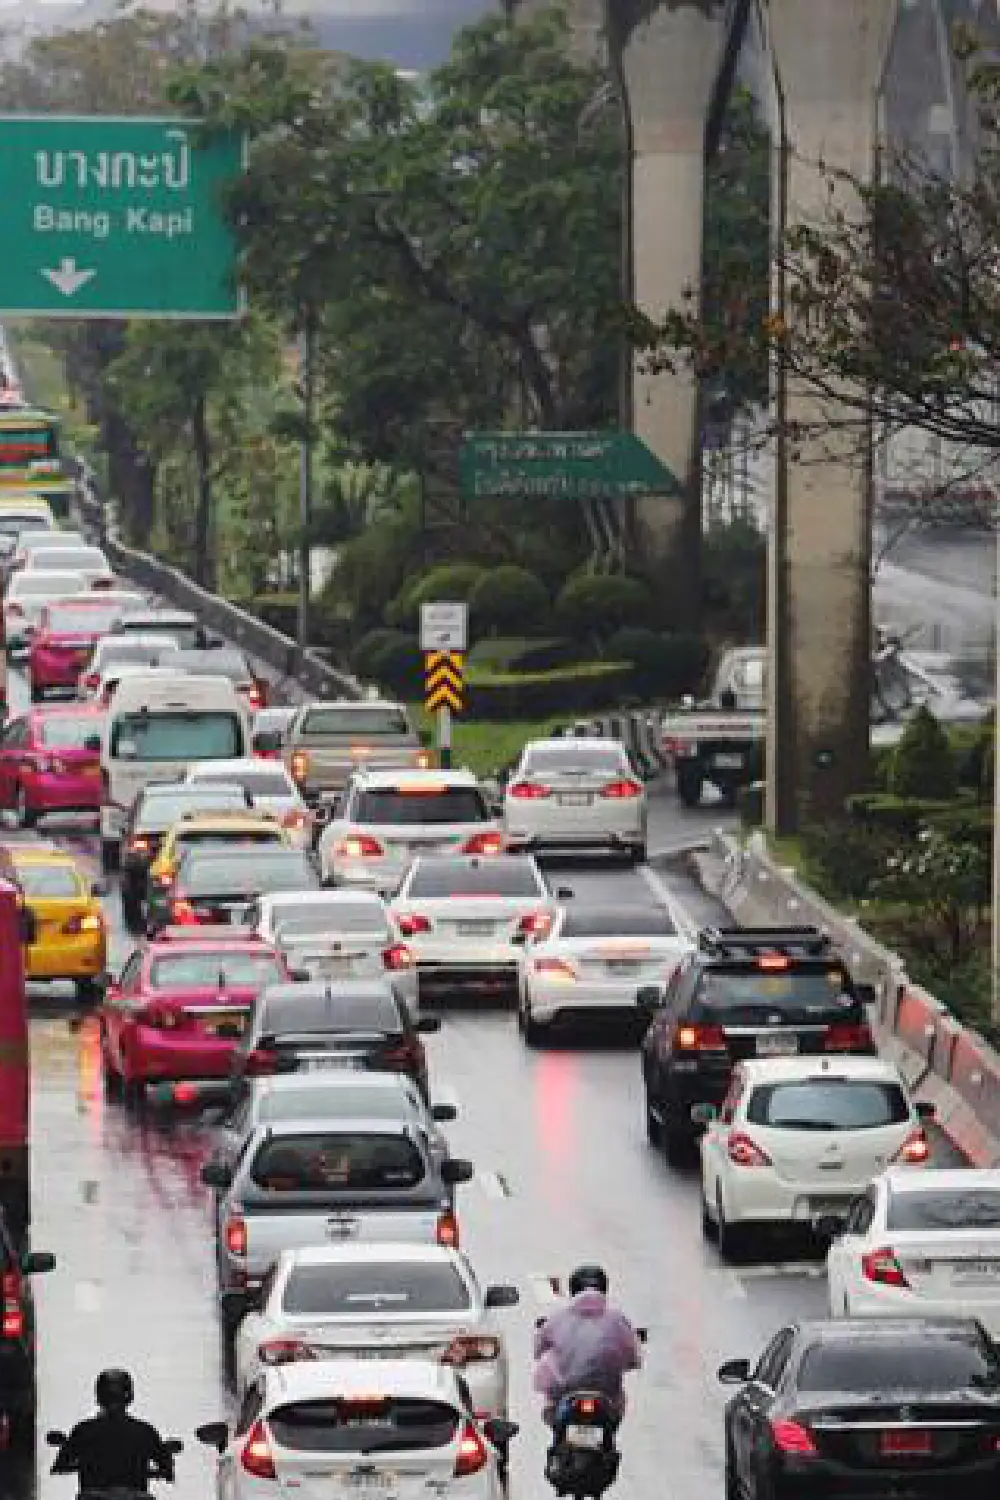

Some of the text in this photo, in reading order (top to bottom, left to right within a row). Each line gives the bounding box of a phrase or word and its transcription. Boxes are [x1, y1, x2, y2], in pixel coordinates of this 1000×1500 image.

[33, 129, 189, 187] บางกะปิ
[33, 204, 193, 239] Bang Kapi
